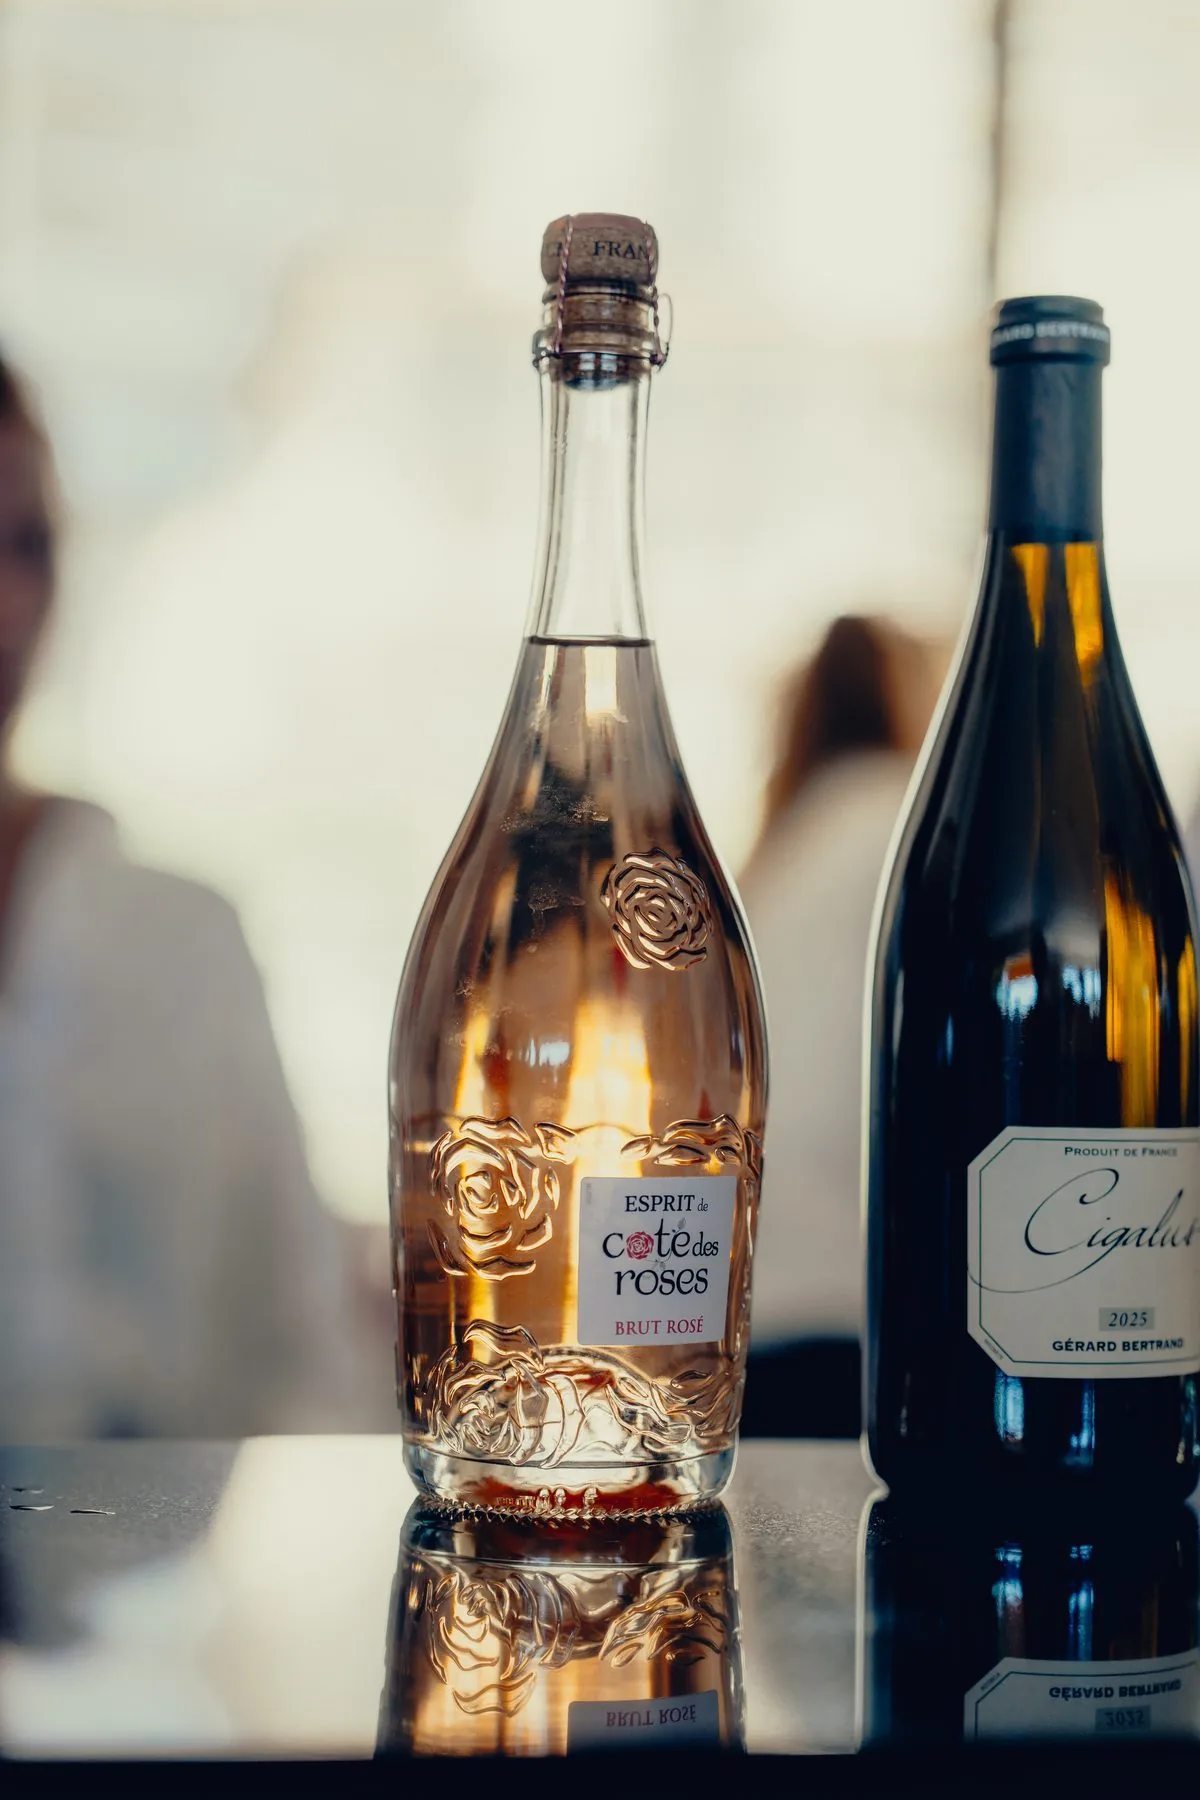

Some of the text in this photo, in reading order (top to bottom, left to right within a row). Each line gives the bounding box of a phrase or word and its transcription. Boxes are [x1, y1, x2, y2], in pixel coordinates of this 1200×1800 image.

[1065, 1147, 1178, 1157] PRODUIT DE FRANCE
[625, 1195, 709, 1212] ESPRIT de
[692, 1232, 719, 1257] des
[614, 1268, 709, 1296] roses
[615, 1316, 704, 1335] BRUT ROSÉ
[1108, 1311, 1149, 1328] 2025
[1052, 1337, 1185, 1352] GÉRARD BERTRAND
